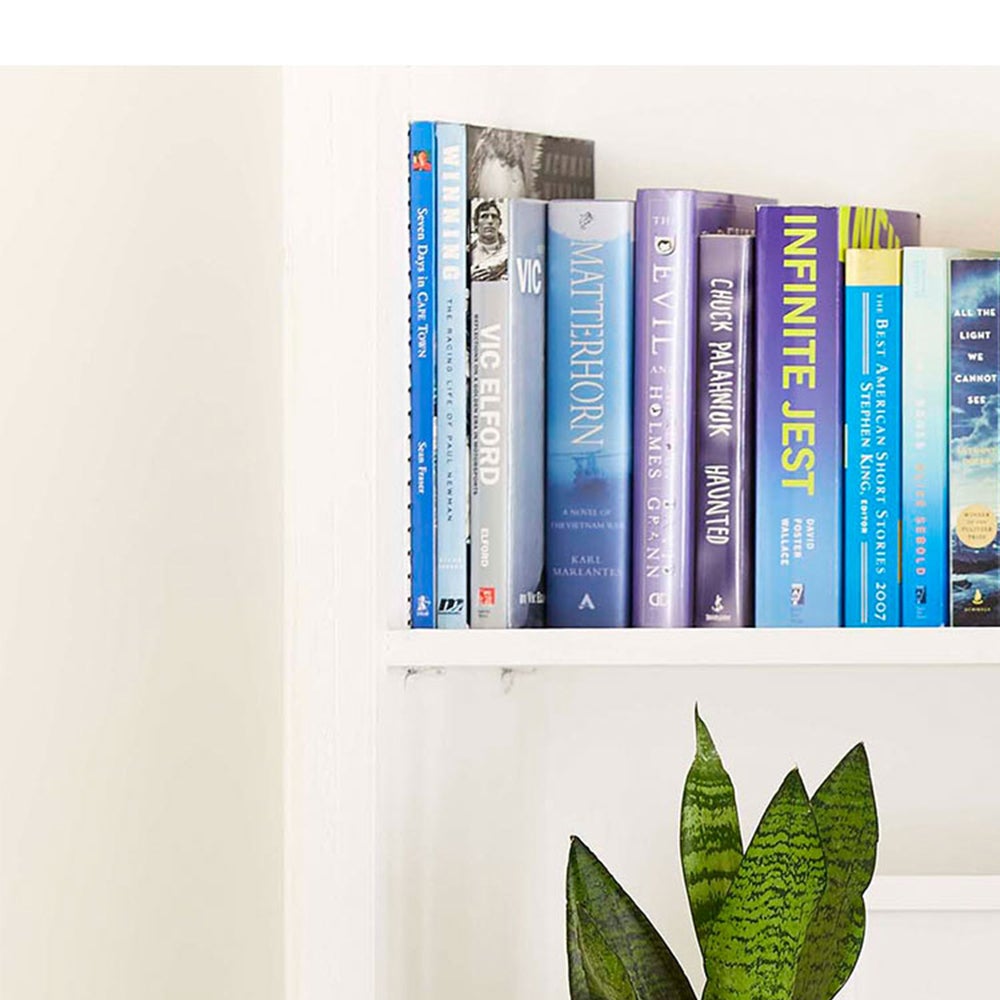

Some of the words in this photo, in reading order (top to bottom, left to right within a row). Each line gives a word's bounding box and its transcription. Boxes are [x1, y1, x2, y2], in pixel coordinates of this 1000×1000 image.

[415, 208, 429, 241] Seven
[442, 145, 462, 281] WINNING
[414, 245, 429, 273] Days
[515, 257, 542, 295] VIC
[417, 276, 429, 287] in
[417, 291, 429, 321] CAPE
[710, 278, 735, 332] CHUCK
[782, 215, 818, 389] INFINITE
[876, 294, 884, 314] THE
[953, 308, 974, 318] ALL
[975, 308, 997, 318] THE
[418, 324, 430, 358] TOWN
[479, 324, 502, 368] VIC
[569, 242, 605, 446] MATTERHORN
[875, 319, 889, 357] BEST
[958, 331, 991, 341] LIGHT
[967, 353, 984, 361] WE
[708, 342, 734, 438] PALAHNIUK
[954, 374, 998, 384] CANNOT
[447, 413, 453, 427] OF
[859, 382, 873, 452] STEPHEN
[875, 363, 889, 446] AMERICAN
[966, 396, 987, 405] SEE
[479, 378, 501, 486] ELFORD
[781, 400, 817, 497] JEST
[417, 441, 428, 464] Sean
[418, 466, 428, 495] Fraser
[858, 453, 873, 496] KING,
[875, 451, 888, 503] SHORT
[704, 465, 731, 545] HAUNTED
[480, 528, 489, 568] ELFORD
[780, 518, 790, 566] WALLACE
[793, 518, 803, 558] FOSTER
[806, 518, 815, 549] DAVID
[874, 510, 888, 575] STORIES
[915, 516, 927, 576] SEBOLD
[874, 582, 888, 622] 2007
